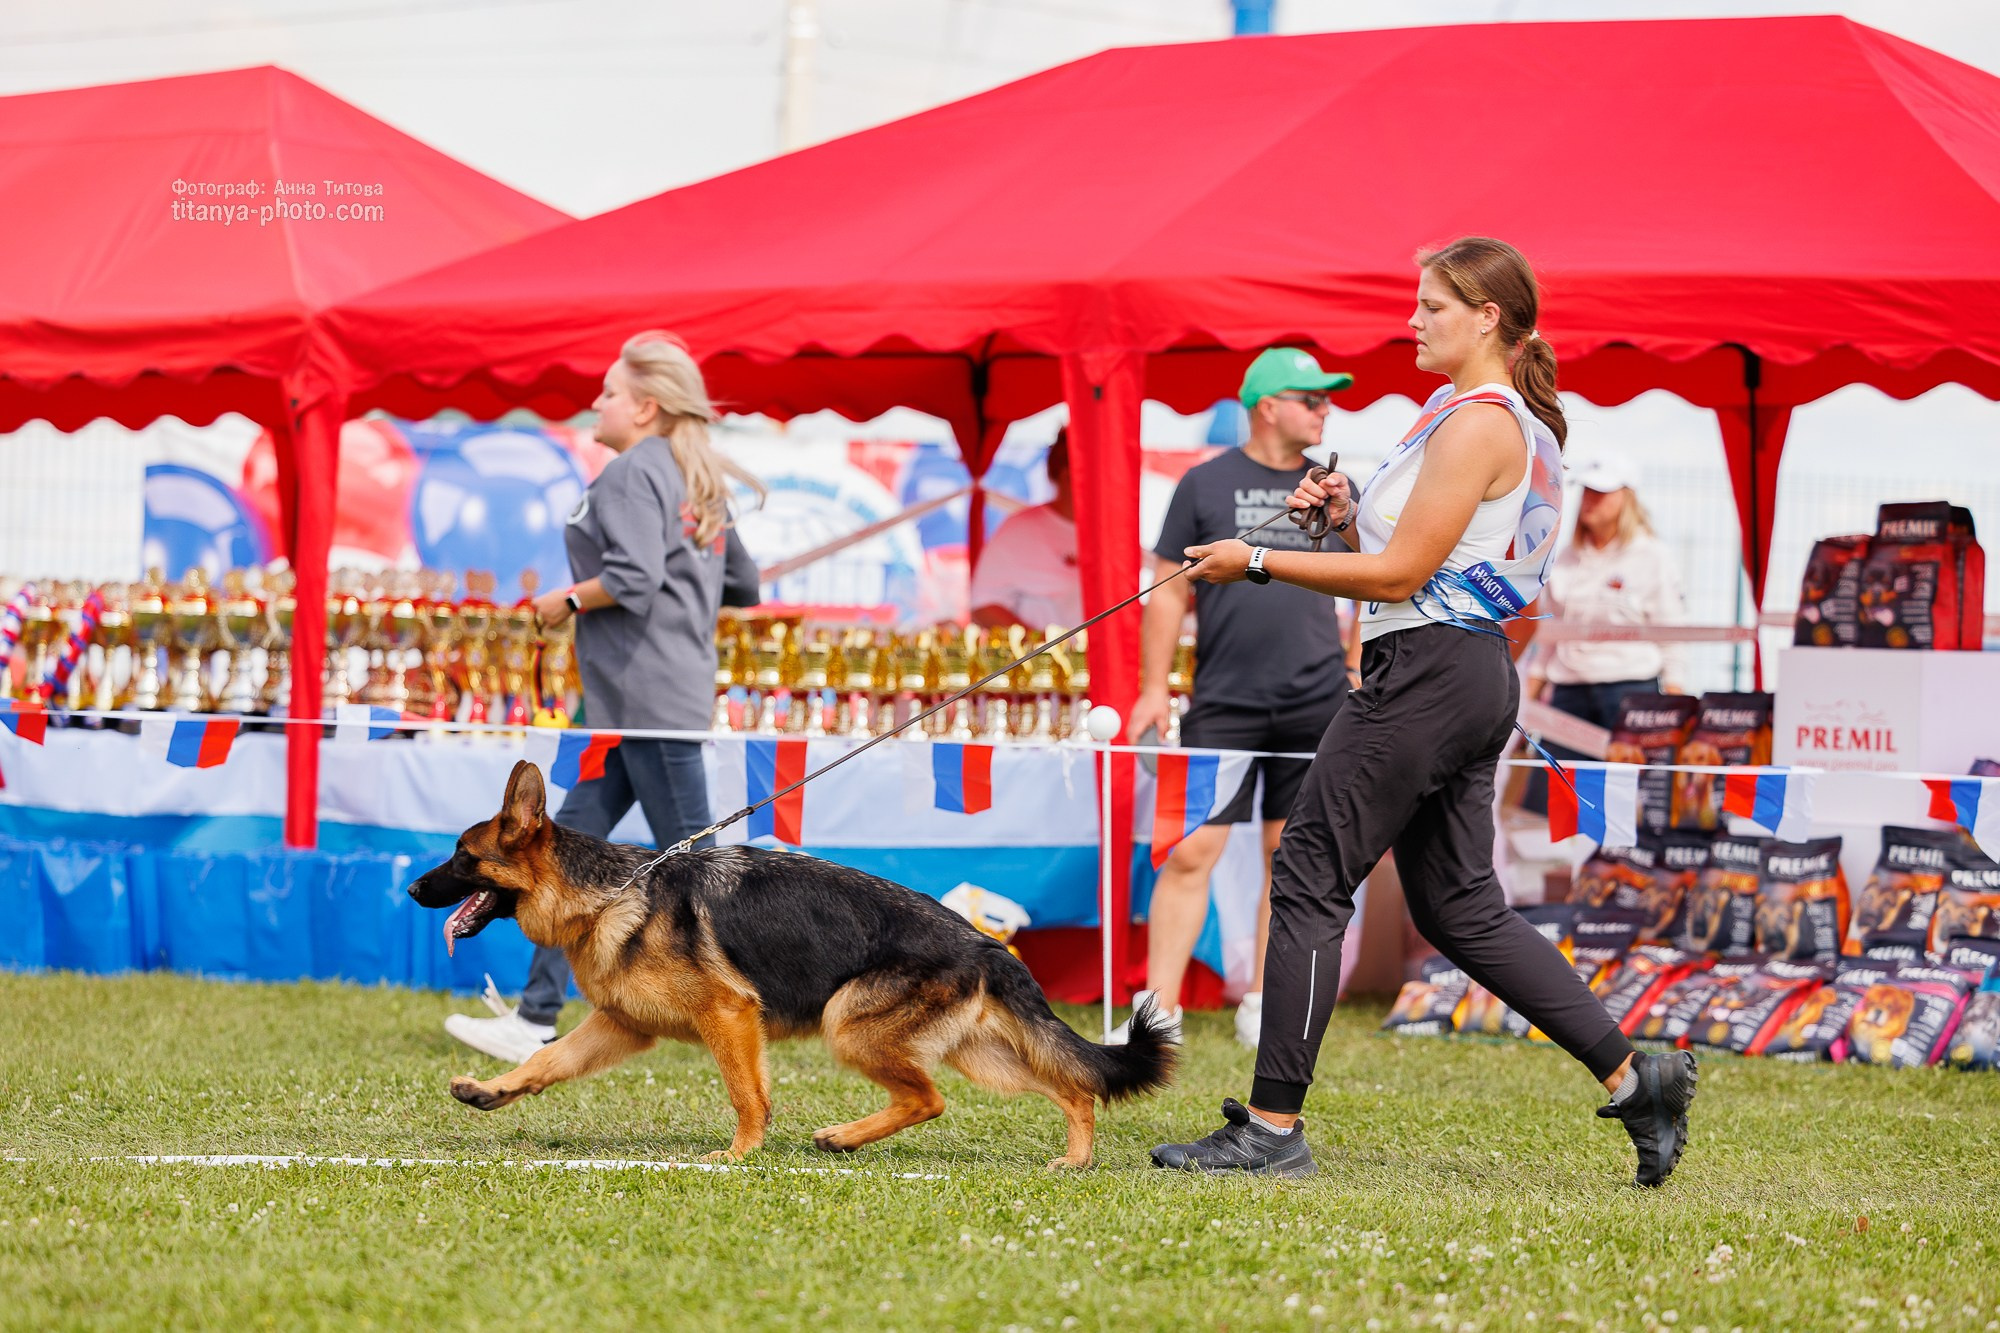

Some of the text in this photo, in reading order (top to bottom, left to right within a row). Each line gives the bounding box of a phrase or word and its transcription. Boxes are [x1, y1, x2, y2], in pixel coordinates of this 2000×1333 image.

[1234, 488, 1294, 507] UND
[1880, 519, 1939, 538] PREMIL
[1796, 725, 1898, 753] PREMIL
